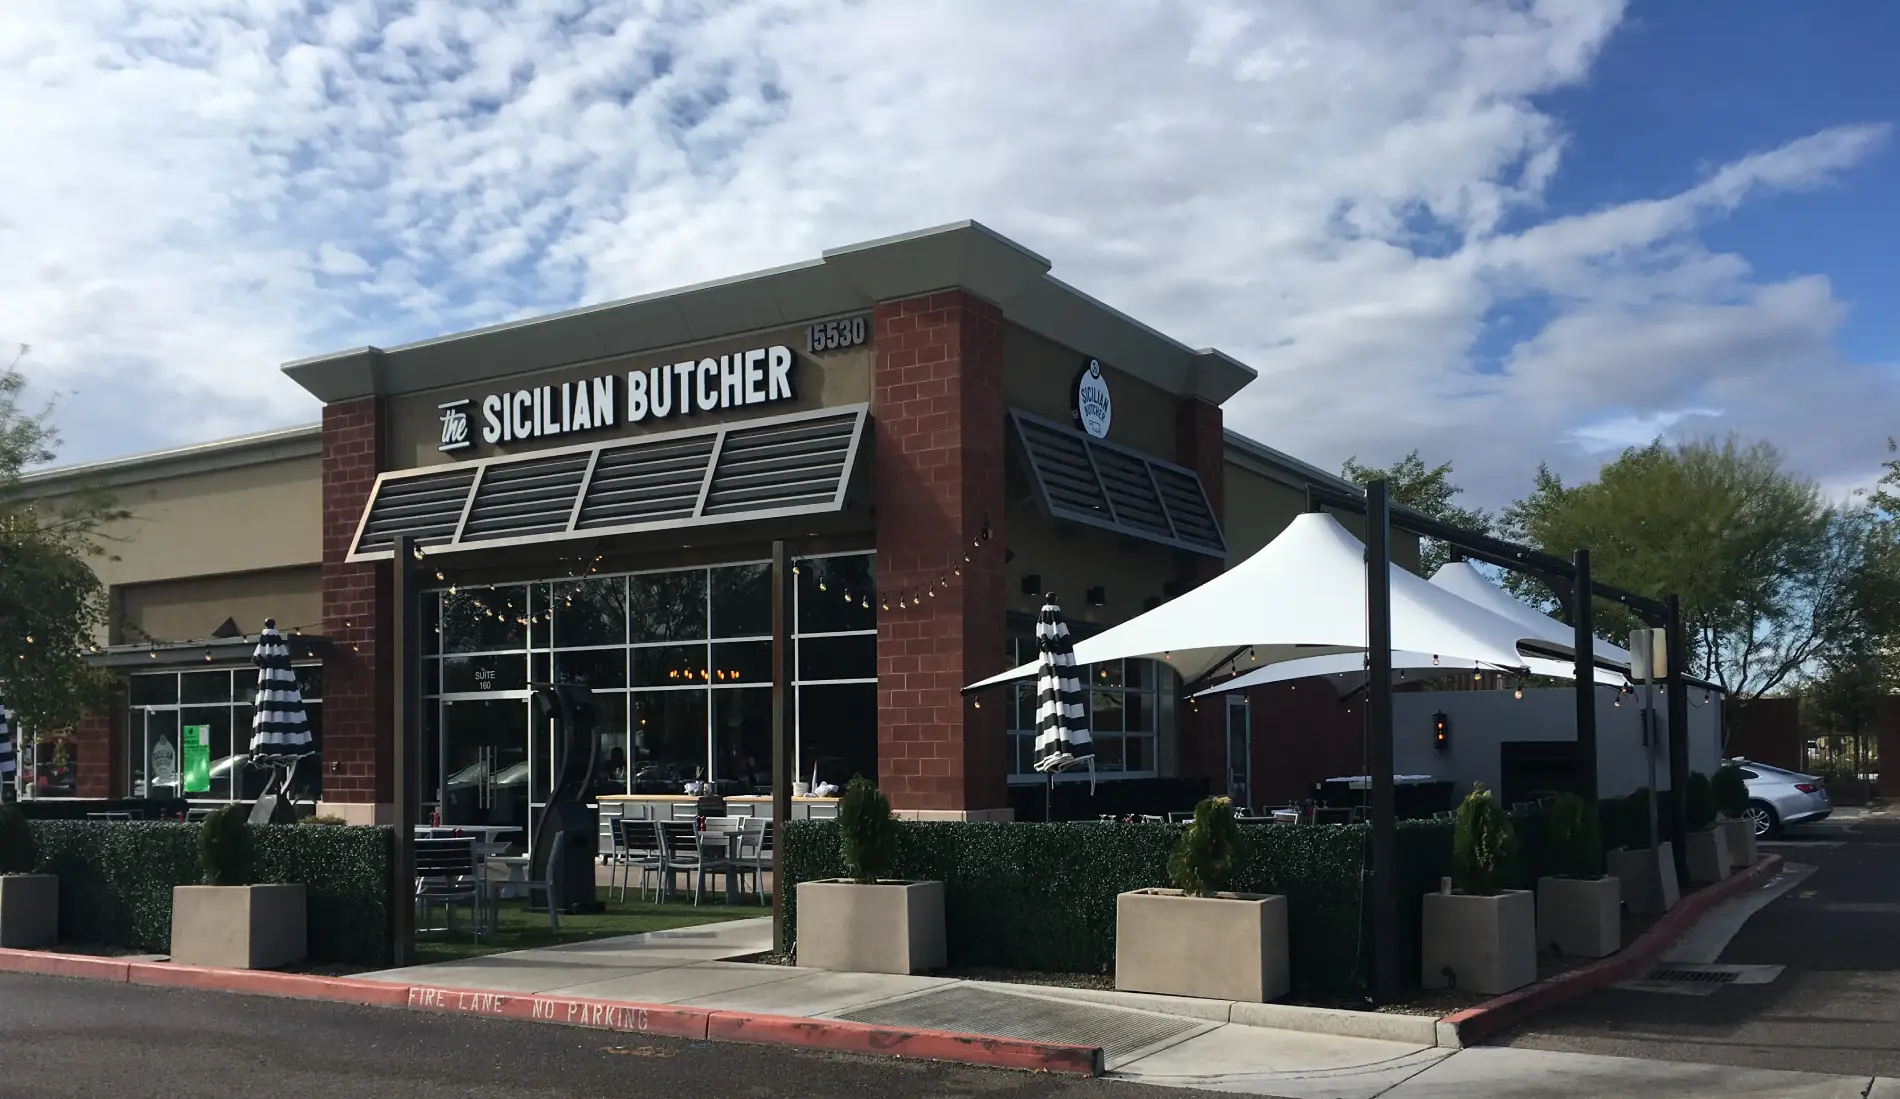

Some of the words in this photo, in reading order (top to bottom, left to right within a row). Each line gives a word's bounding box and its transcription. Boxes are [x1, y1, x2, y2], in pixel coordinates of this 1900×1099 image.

[805, 316, 866, 352] 15530
[439, 408, 468, 443] the
[482, 374, 615, 444] SICILIAN
[627, 345, 793, 423] BUTCHER
[1081, 387, 1109, 413] SICILIAN
[475, 671, 495, 680] SUITE
[480, 682, 491, 690] 160
[407, 986, 444, 1008] FIRE
[458, 991, 503, 1013] LANE
[532, 999, 554, 1020] NO
[568, 1001, 648, 1031] PARKING
